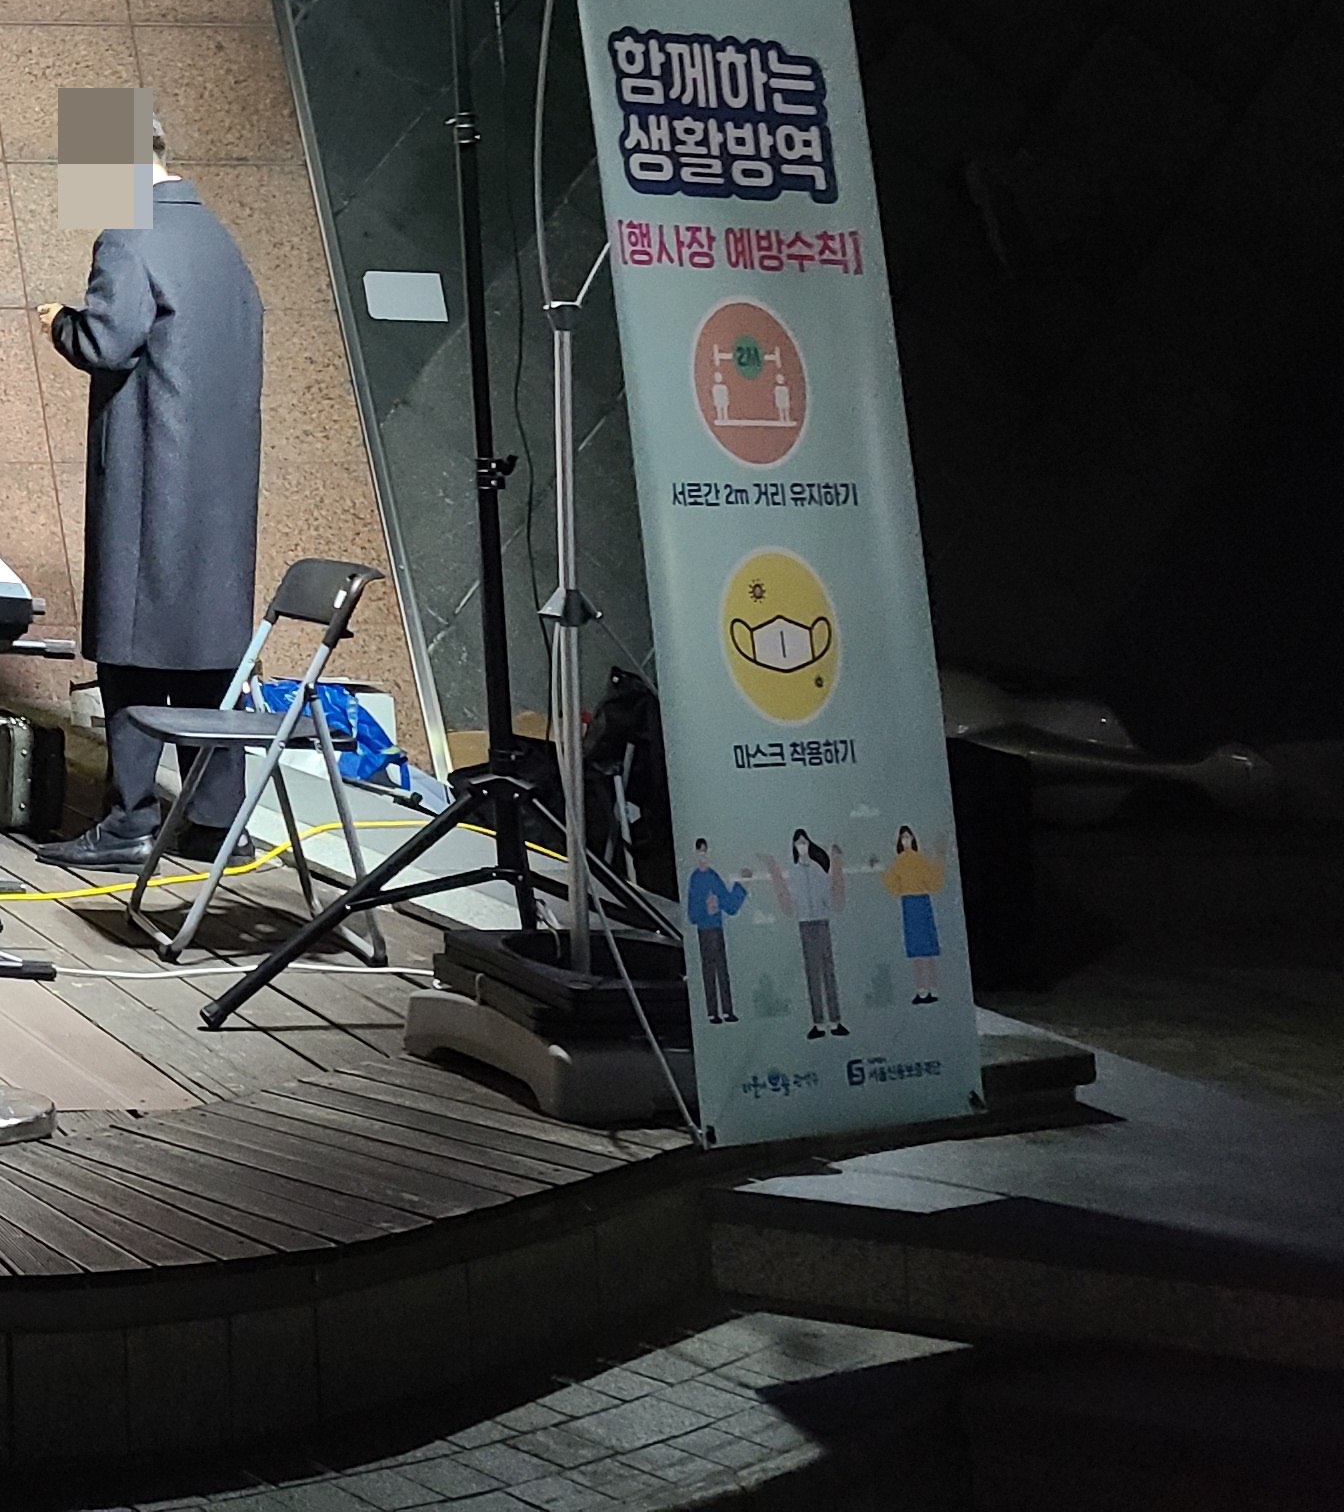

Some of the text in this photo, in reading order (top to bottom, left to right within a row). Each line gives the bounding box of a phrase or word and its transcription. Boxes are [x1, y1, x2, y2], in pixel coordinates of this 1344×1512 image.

[613, 35, 818, 116] 함께하는
[623, 113, 828, 191] 생활방역
[672, 482, 859, 507] 서로간 2m 거리 유지하기
[733, 739, 857, 769] 마스크 착용하기
